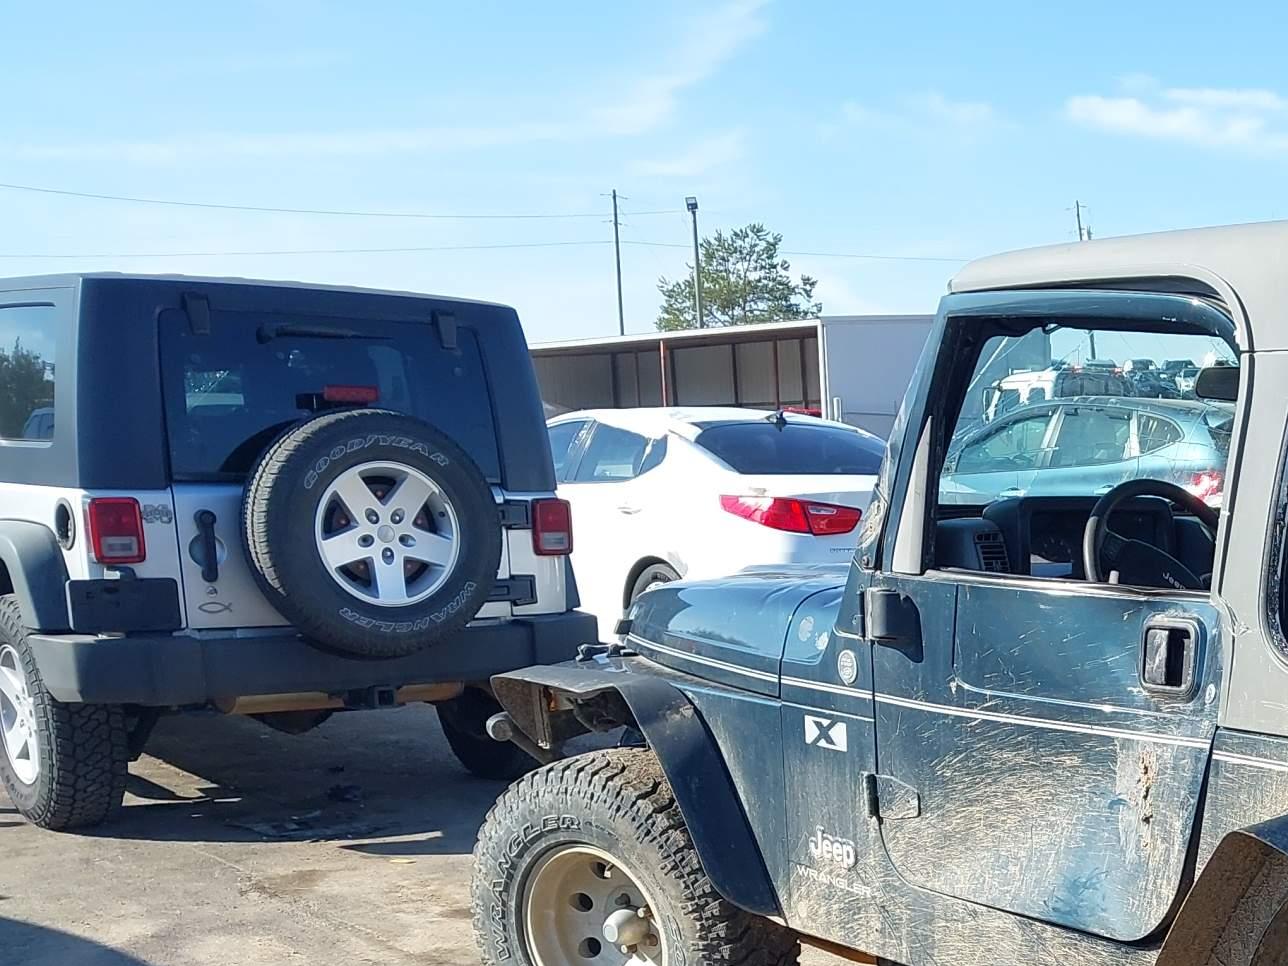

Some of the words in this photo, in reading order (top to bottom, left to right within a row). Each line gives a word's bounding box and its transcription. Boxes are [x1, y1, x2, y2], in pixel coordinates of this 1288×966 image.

[339, 582, 477, 633] WRANGLER
[808, 824, 858, 870] Jeep
[489, 814, 581, 961] WRANGLER
